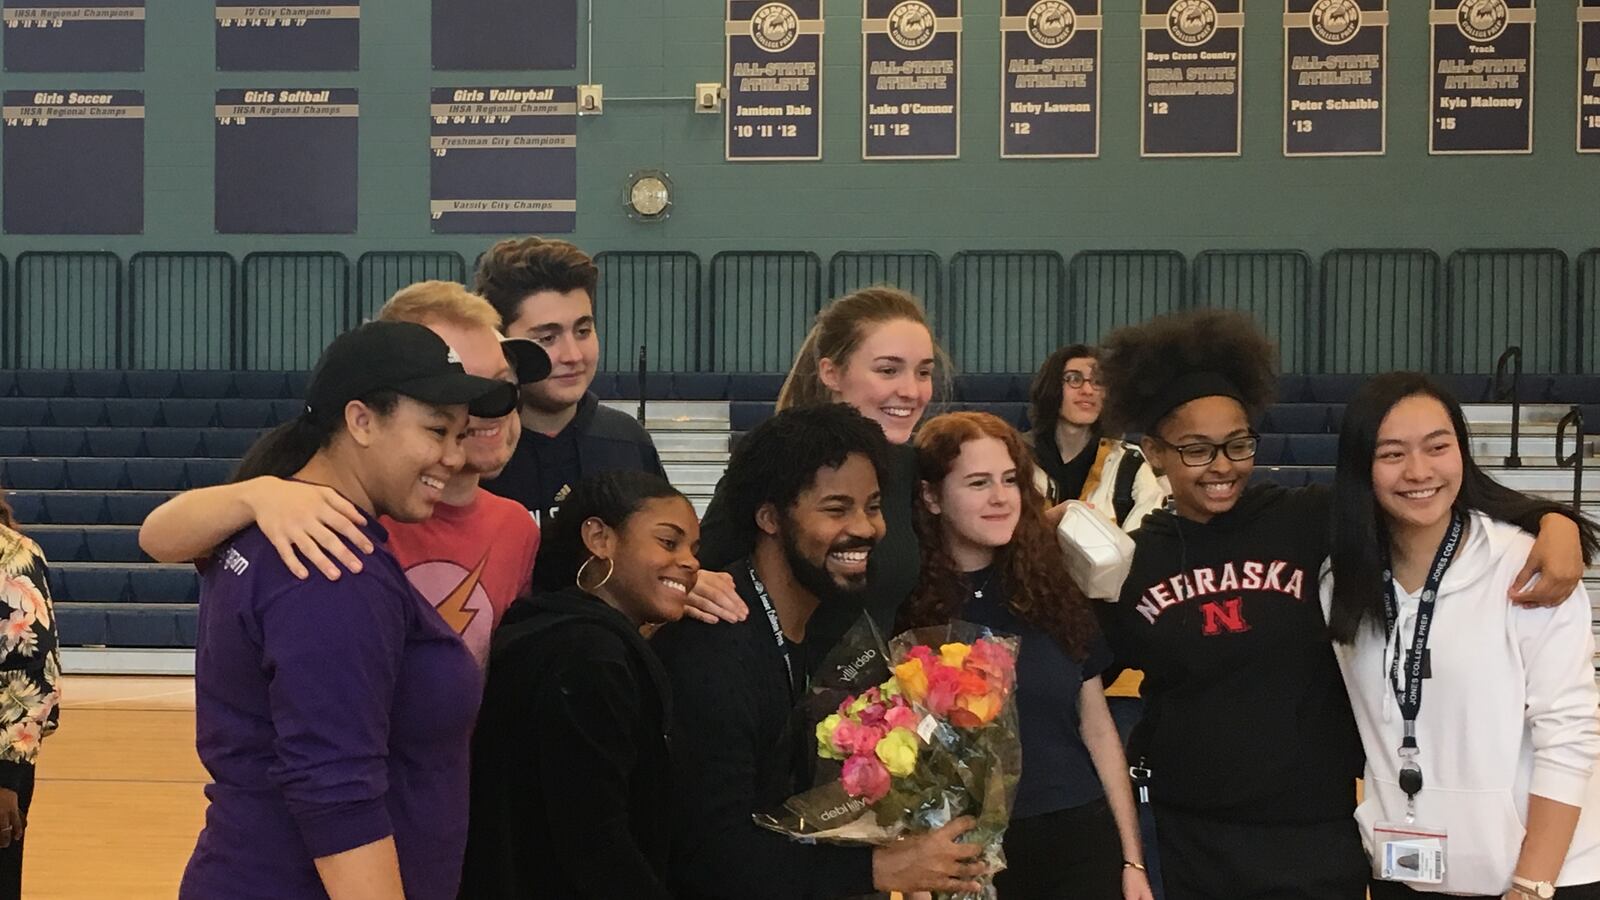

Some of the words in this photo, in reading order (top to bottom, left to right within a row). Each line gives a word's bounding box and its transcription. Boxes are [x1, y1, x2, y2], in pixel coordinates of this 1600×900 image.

[40, 9, 80, 18] Regional
[84, 9, 135, 18] Champions
[258, 8, 276, 16] City
[280, 8, 331, 16] Champions
[1172, 52, 1198, 60] Cross
[1200, 51, 1237, 61] Country
[1292, 54, 1379, 70] ALL-STATE
[734, 62, 816, 76] ALL-STATE
[870, 60, 953, 74] ALL-STATE
[1008, 58, 1093, 72] ALL-STATE
[1438, 59, 1526, 73] ALL-STATE
[1186, 67, 1236, 80] STATE
[1298, 70, 1372, 85] ATHLETE
[740, 78, 809, 91] ATHLETE
[876, 76, 947, 90] ATHLETE
[1015, 74, 1086, 88] ATHLETE
[1444, 75, 1519, 89] ATHLETE
[1148, 82, 1234, 96] CHAMPIONS
[34, 92, 64, 104] Girls
[68, 92, 113, 104] Soccer
[244, 90, 275, 103] Girls
[279, 90, 330, 103] Softball
[453, 90, 484, 102] Girls
[490, 89, 554, 103] Volleyball
[476, 105, 516, 114] Regional
[520, 104, 558, 113] Champs
[869, 104, 898, 114] Luke
[901, 103, 954, 114] O'Connor
[1010, 102, 1042, 115] Kirby
[1044, 102, 1091, 112] Lawson
[1148, 102, 1168, 114] '12
[1291, 100, 1323, 110] Peter
[1326, 99, 1379, 110] Schaible
[1440, 96, 1467, 110] Kyle
[1471, 96, 1523, 109] Maloney
[46, 107, 86, 116] Regional
[90, 107, 126, 116] Champs
[260, 106, 300, 115] Regional
[304, 106, 341, 115] Champs
[736, 105, 783, 116] Jamison
[786, 105, 812, 116] Dale
[869, 124, 885, 136] '11
[890, 124, 910, 136] '12
[1010, 122, 1030, 134] '12
[1292, 120, 1312, 132] '13
[1436, 117, 1456, 130] '15
[734, 125, 753, 137] '10
[757, 125, 773, 137] '11
[777, 125, 797, 137] '12
[441, 137, 488, 146] Freshman
[492, 137, 511, 146] City
[514, 137, 566, 146] Champions
[453, 201, 487, 210] Varsity
[491, 201, 510, 210] City
[514, 201, 552, 210] Champs
[1135, 560, 1304, 625] NEBRASKA
[1200, 596, 1250, 636] N
[1418, 614, 1429, 636] PREP
[1412, 638, 1424, 676] COLLEGE
[1409, 678, 1419, 705] JONES
[820, 804, 848, 821] debi
[848, 797, 866, 812] lilly
